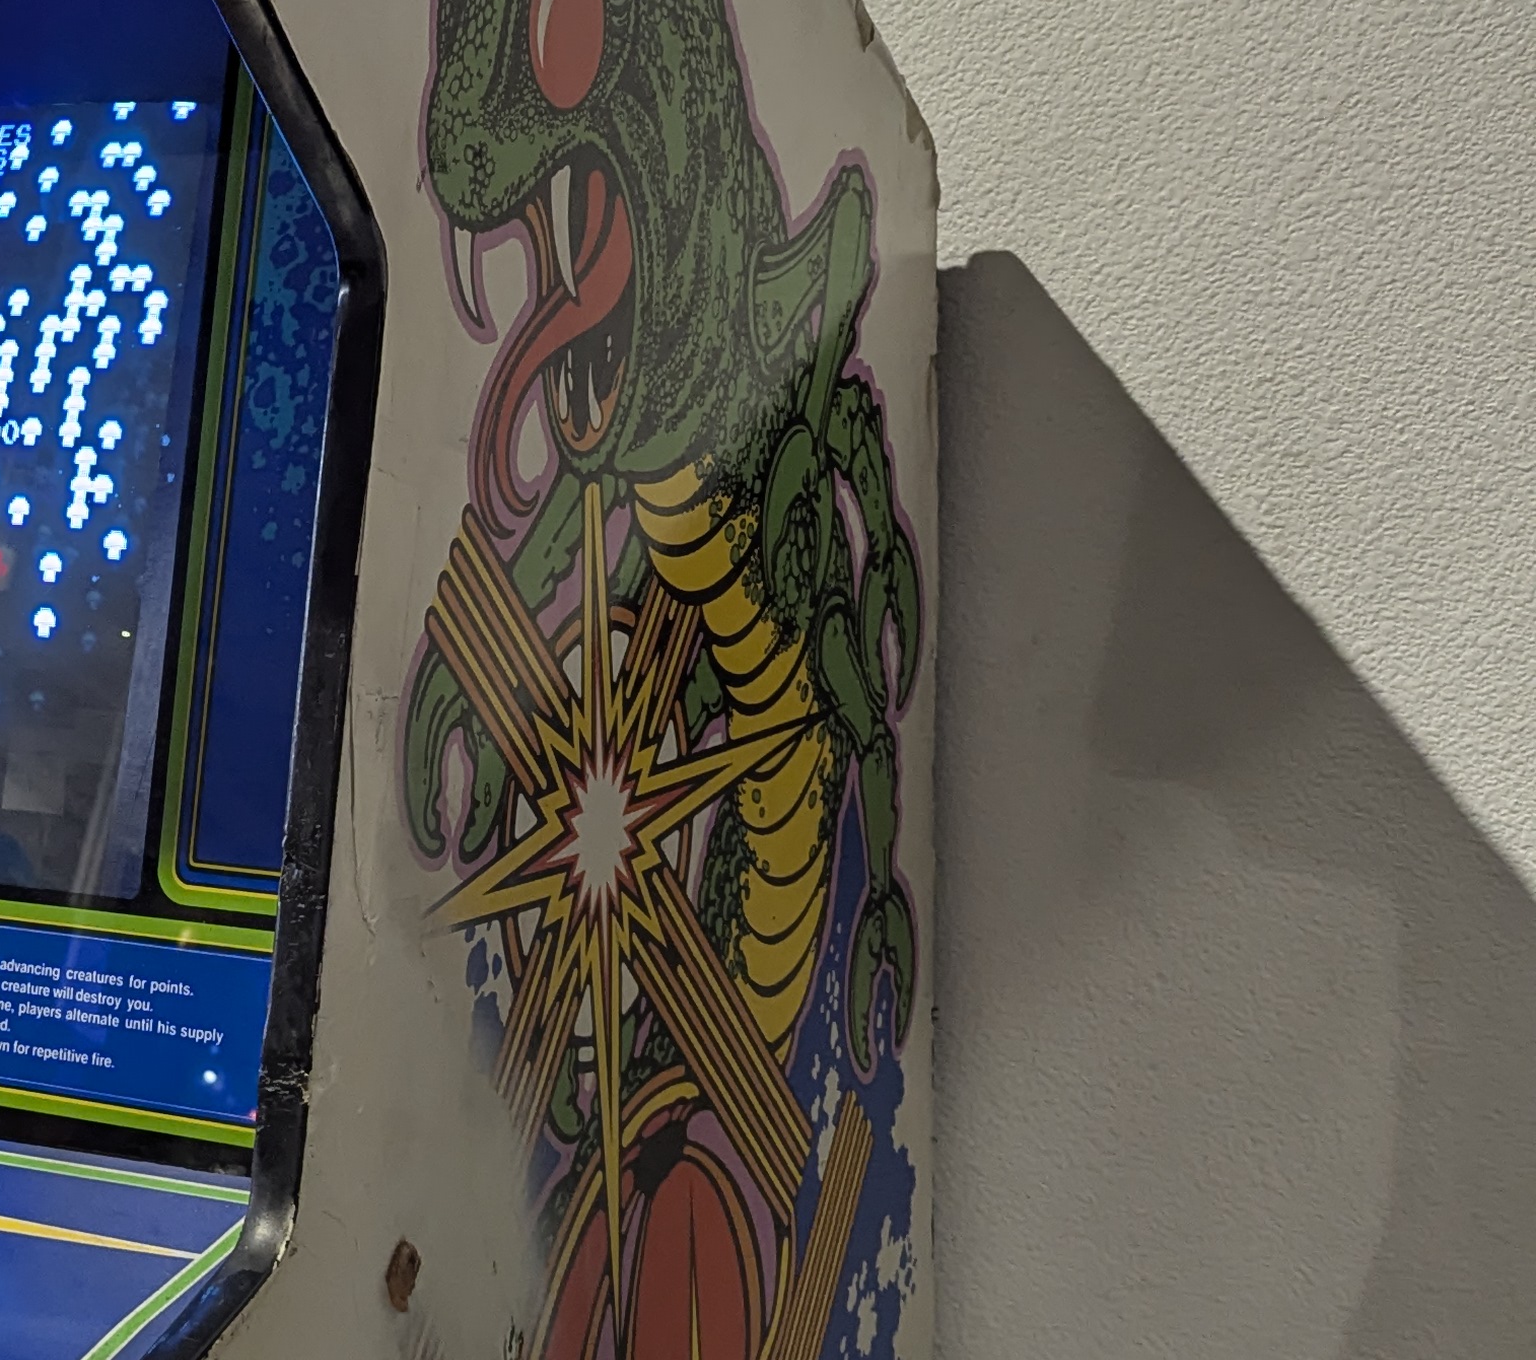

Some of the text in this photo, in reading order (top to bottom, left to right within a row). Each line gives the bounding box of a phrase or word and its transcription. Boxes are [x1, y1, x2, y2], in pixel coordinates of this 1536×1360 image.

[0, 959, 61, 981] advancing
[66, 968, 124, 987] creatures
[129, 975, 147, 990] for
[150, 980, 194, 996] points.
[1, 980, 50, 997] creature
[52, 986, 74, 1000] will
[75, 991, 122, 1010] destroy
[126, 1000, 154, 1013] you.
[18, 1001, 62, 1019] players
[65, 1008, 120, 1027] alternate
[125, 1017, 153, 1032] until
[156, 1020, 177, 1036] his
[180, 1026, 224, 1046] supply
[13, 1040, 30, 1055] for
[32, 1046, 89, 1064] repetitive
[91, 1052, 115, 1069] fire.
